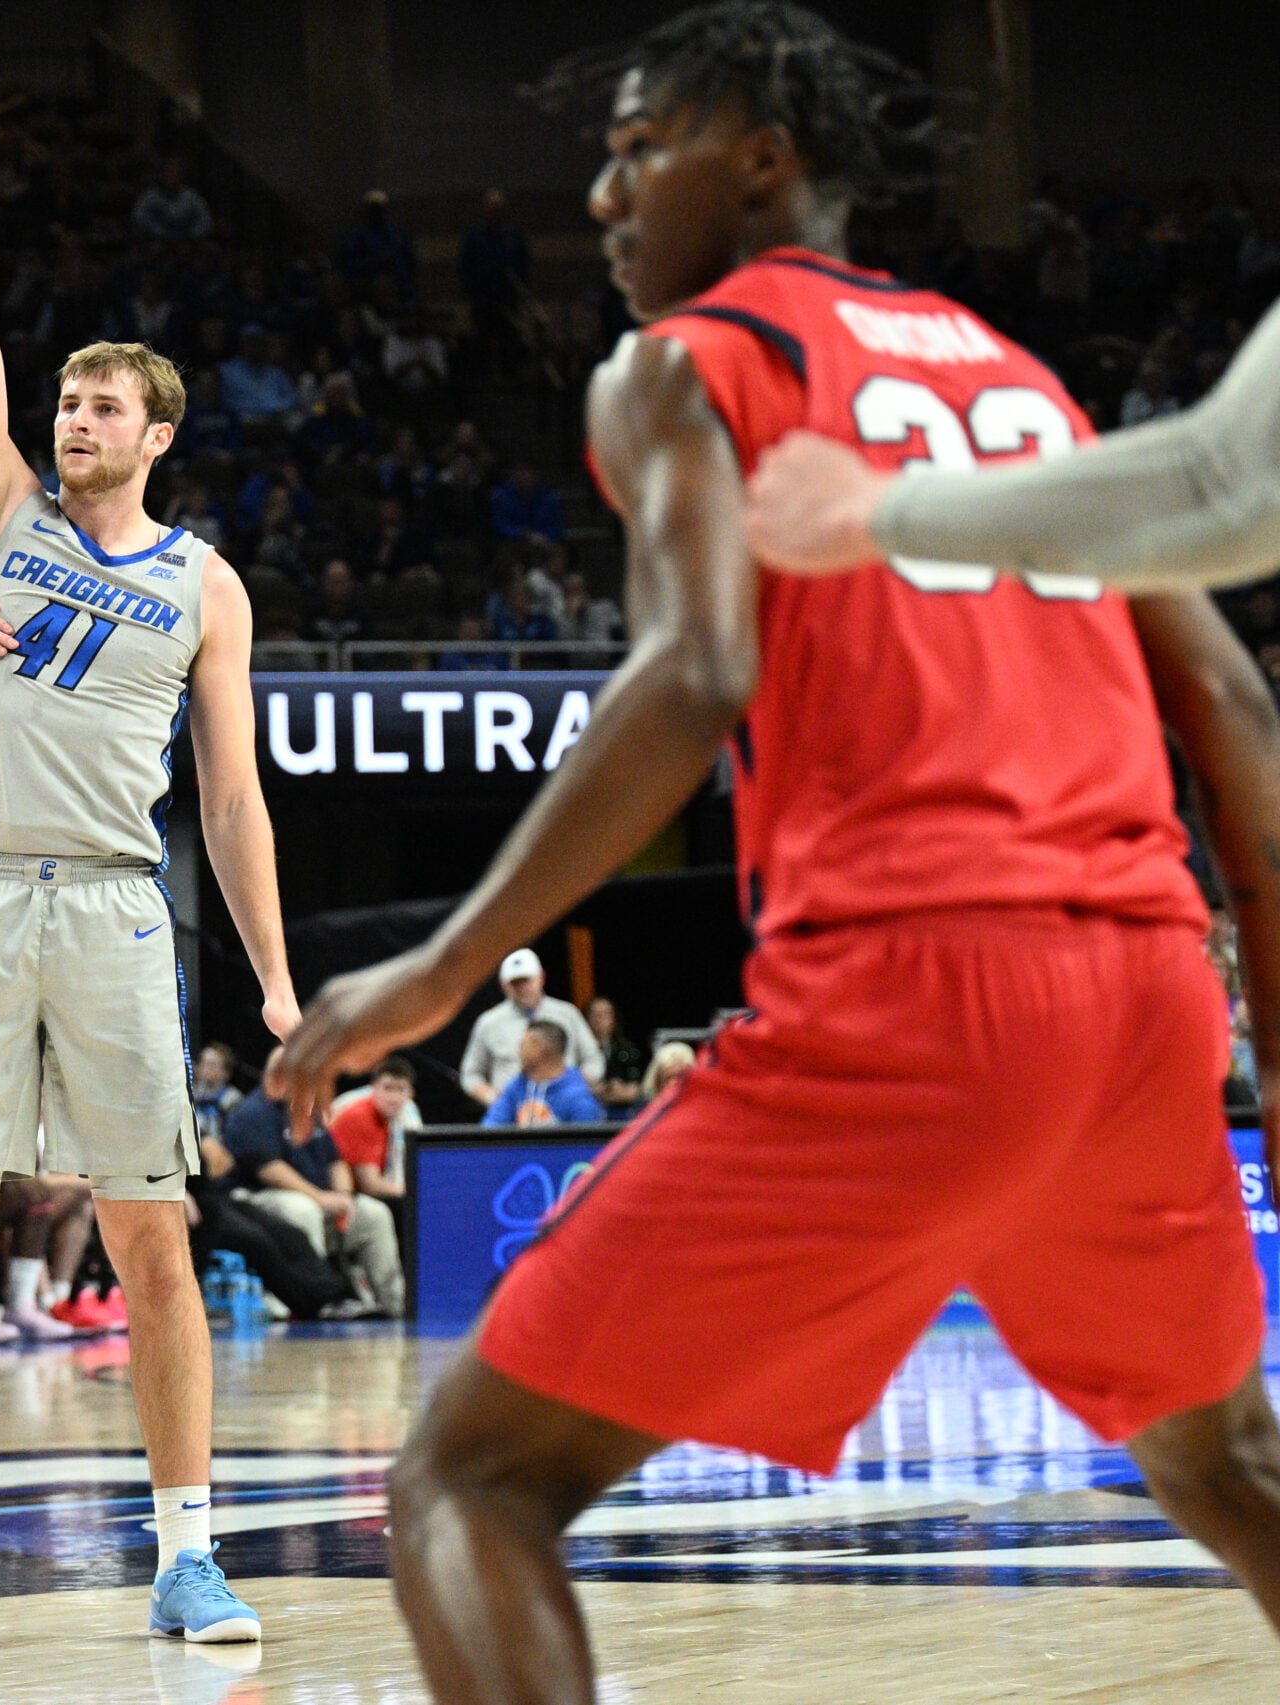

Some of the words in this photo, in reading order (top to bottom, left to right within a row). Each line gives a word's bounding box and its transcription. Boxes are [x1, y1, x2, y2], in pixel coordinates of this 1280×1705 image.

[0, 551, 184, 633] CREIGHTON
[8, 599, 119, 691] 41
[267, 690, 591, 776] ULTRA
[39, 860, 57, 880] C
